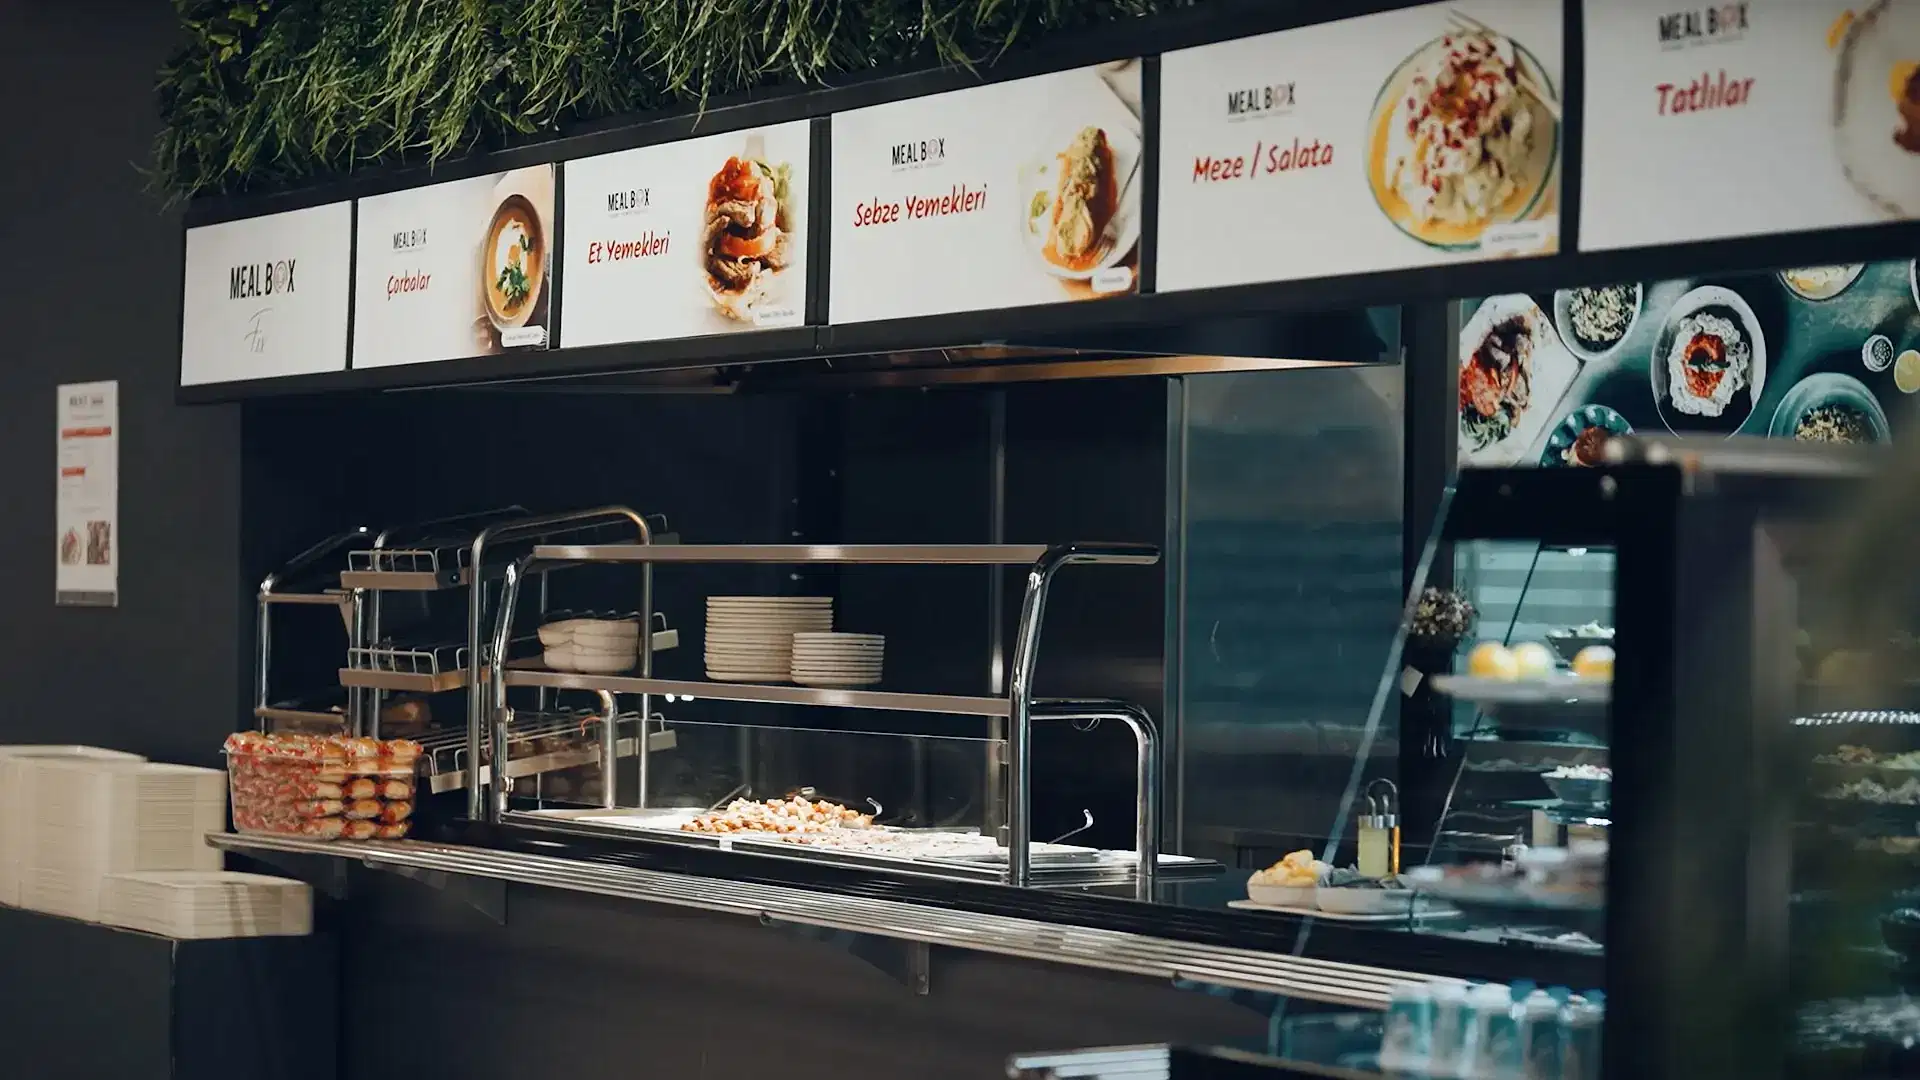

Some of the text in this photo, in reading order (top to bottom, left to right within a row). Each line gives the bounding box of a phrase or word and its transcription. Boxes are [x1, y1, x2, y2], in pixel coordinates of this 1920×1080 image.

[1658, 13, 1702, 42] MEAL
[1228, 81, 1296, 115] MEAL BOX
[1655, 68, 1756, 116] Tatlılar
[892, 137, 945, 166] MEAL BOX
[1192, 137, 1334, 184] Meze / Salata
[608, 191, 629, 211] MEAL
[854, 183, 988, 228] Sebze Yemekleri
[393, 232, 411, 249] MEAL
[588, 230, 671, 265] Et Yemekleri
[230, 259, 296, 300] MEAL BOX
[387, 267, 431, 301] Çorbalar
